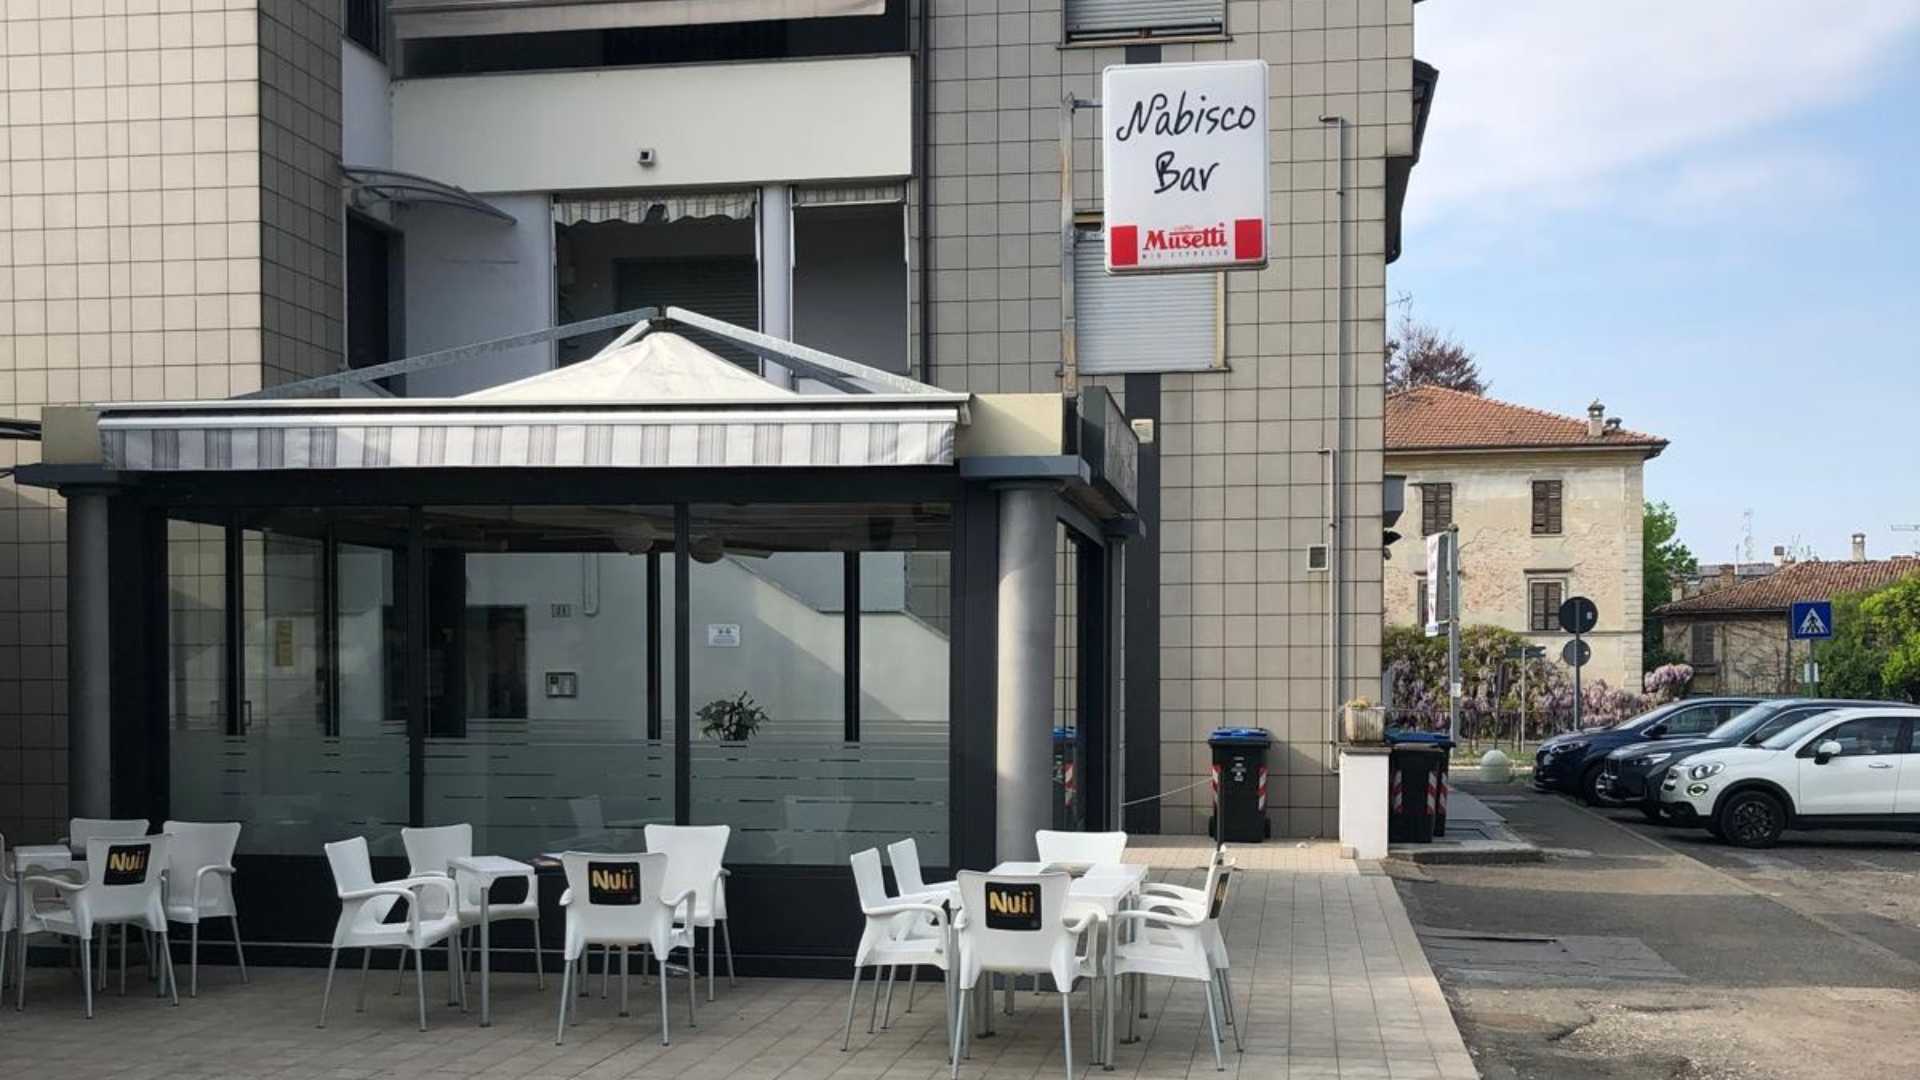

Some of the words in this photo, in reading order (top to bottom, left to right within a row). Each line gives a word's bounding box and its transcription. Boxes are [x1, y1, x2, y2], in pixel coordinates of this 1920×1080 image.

[1116, 91, 1256, 141] Nabisco
[1154, 151, 1219, 193] Bar
[1143, 222, 1227, 249] Musetti
